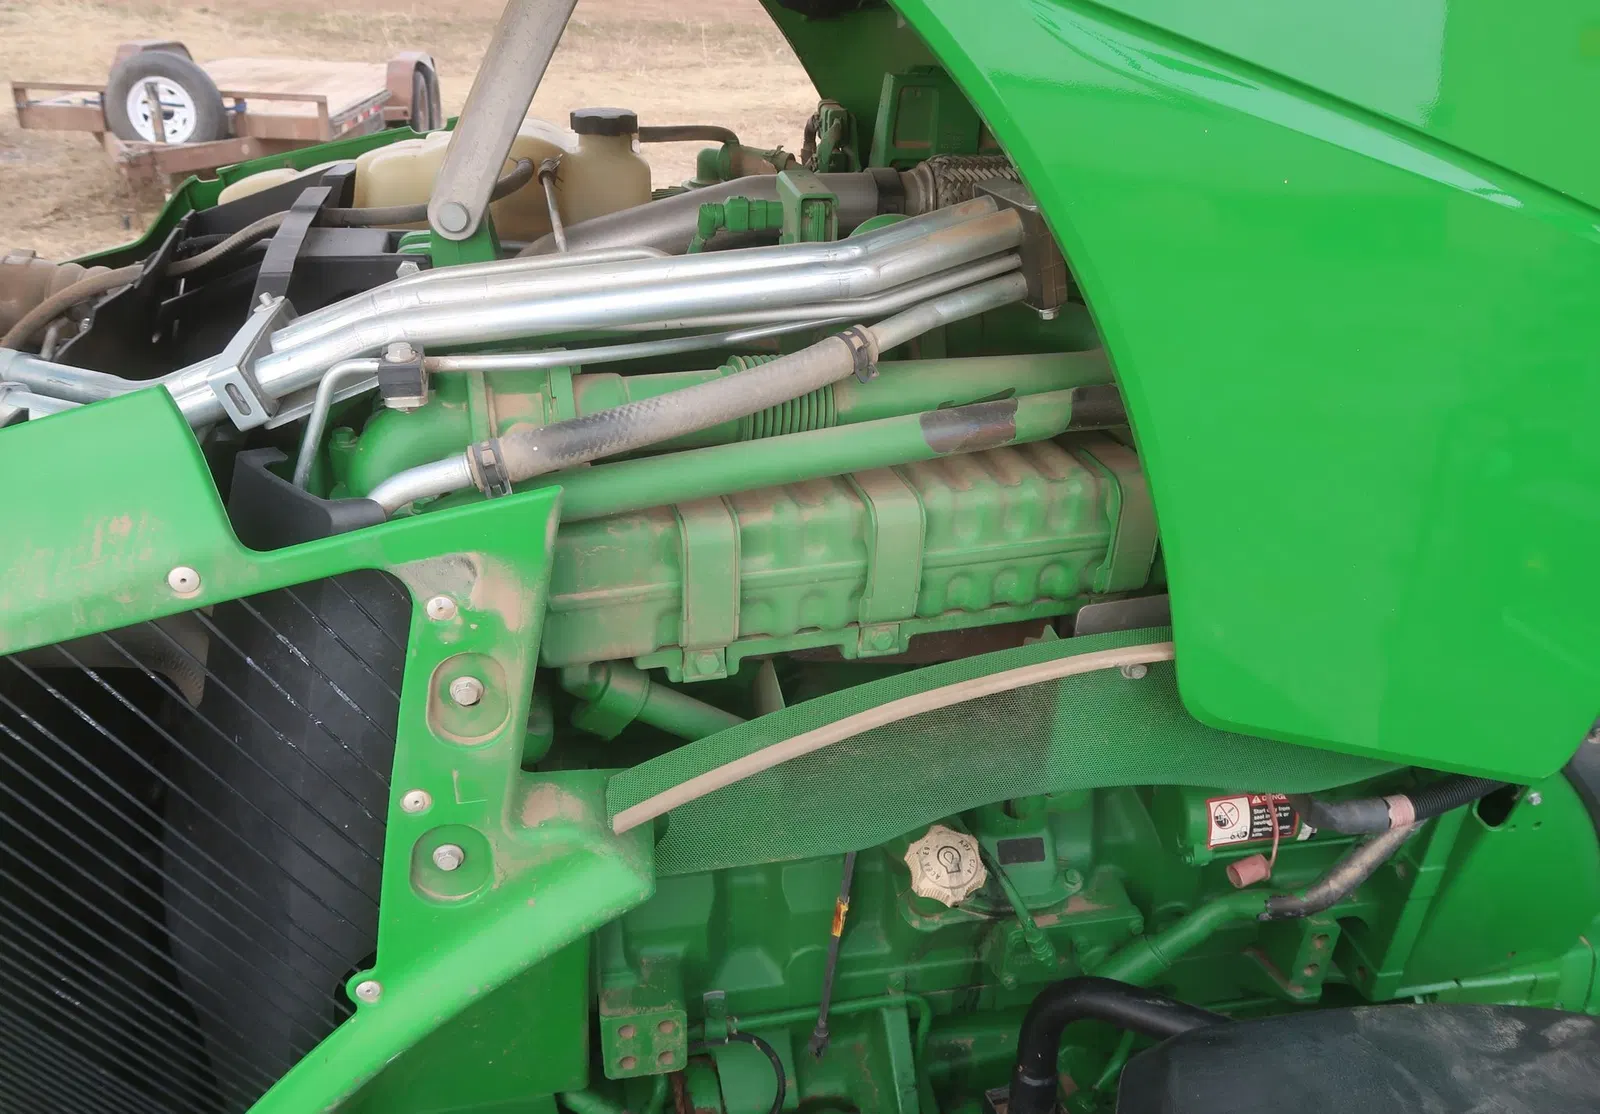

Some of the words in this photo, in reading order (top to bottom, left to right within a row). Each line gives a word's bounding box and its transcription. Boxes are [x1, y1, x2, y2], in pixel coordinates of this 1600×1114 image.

[922, 846, 930, 856] E9
[958, 840, 971, 851] API
[924, 862, 941, 880] ACEA
